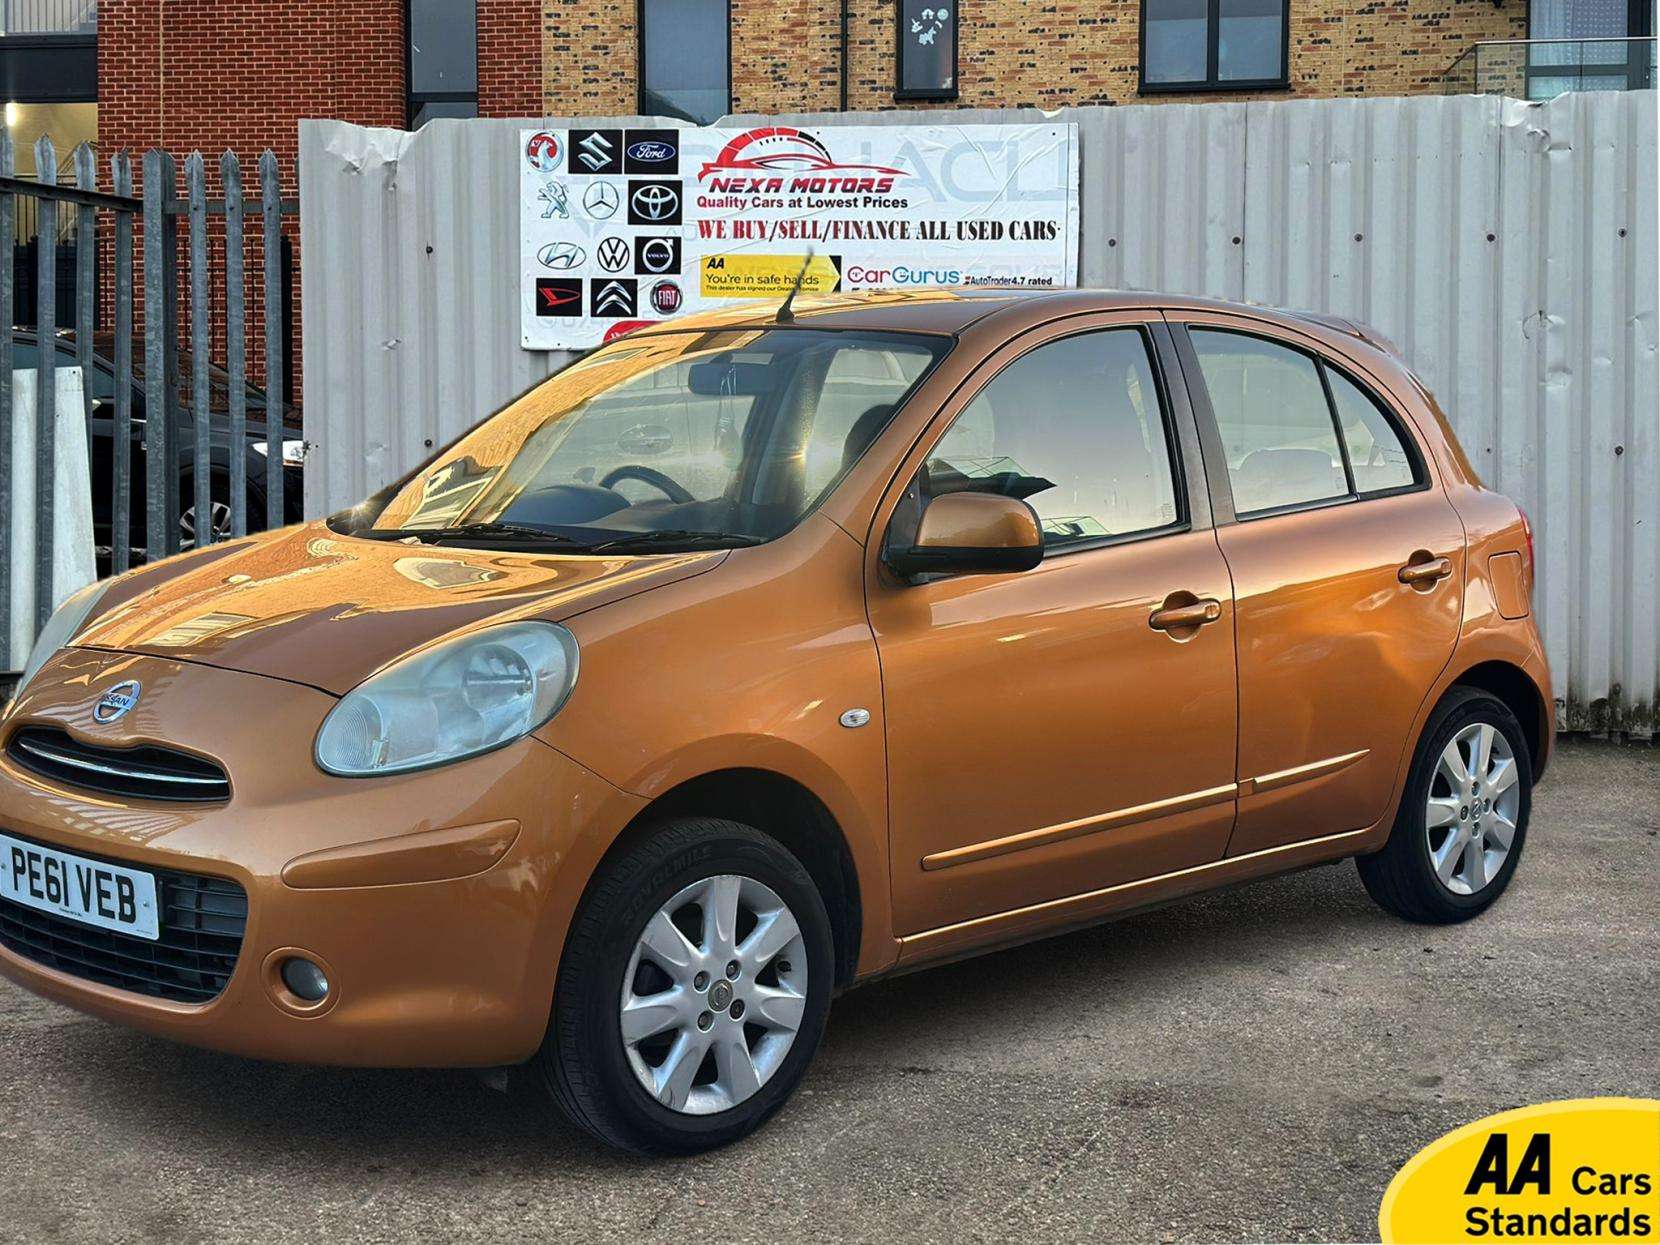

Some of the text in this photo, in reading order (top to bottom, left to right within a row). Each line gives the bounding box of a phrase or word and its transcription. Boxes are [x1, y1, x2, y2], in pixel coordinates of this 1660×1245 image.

[636, 143, 667, 159] Ford
[708, 178, 895, 194] NEXA MOTORS
[697, 196, 908, 210] Quality Cars at Lowest Prices
[697, 220, 727, 240] WE
[915, 220, 950, 240] ALL
[956, 220, 1004, 240] USED
[1008, 220, 1057, 240] CARS
[706, 258, 725, 269] AA
[705, 273, 819, 285] You're in safe hands
[847, 266, 960, 284] CarGurus
[1028, 276, 1053, 286] rated
[658, 290, 677, 306] FIAT
[11, 846, 137, 924] PE61 VEB
